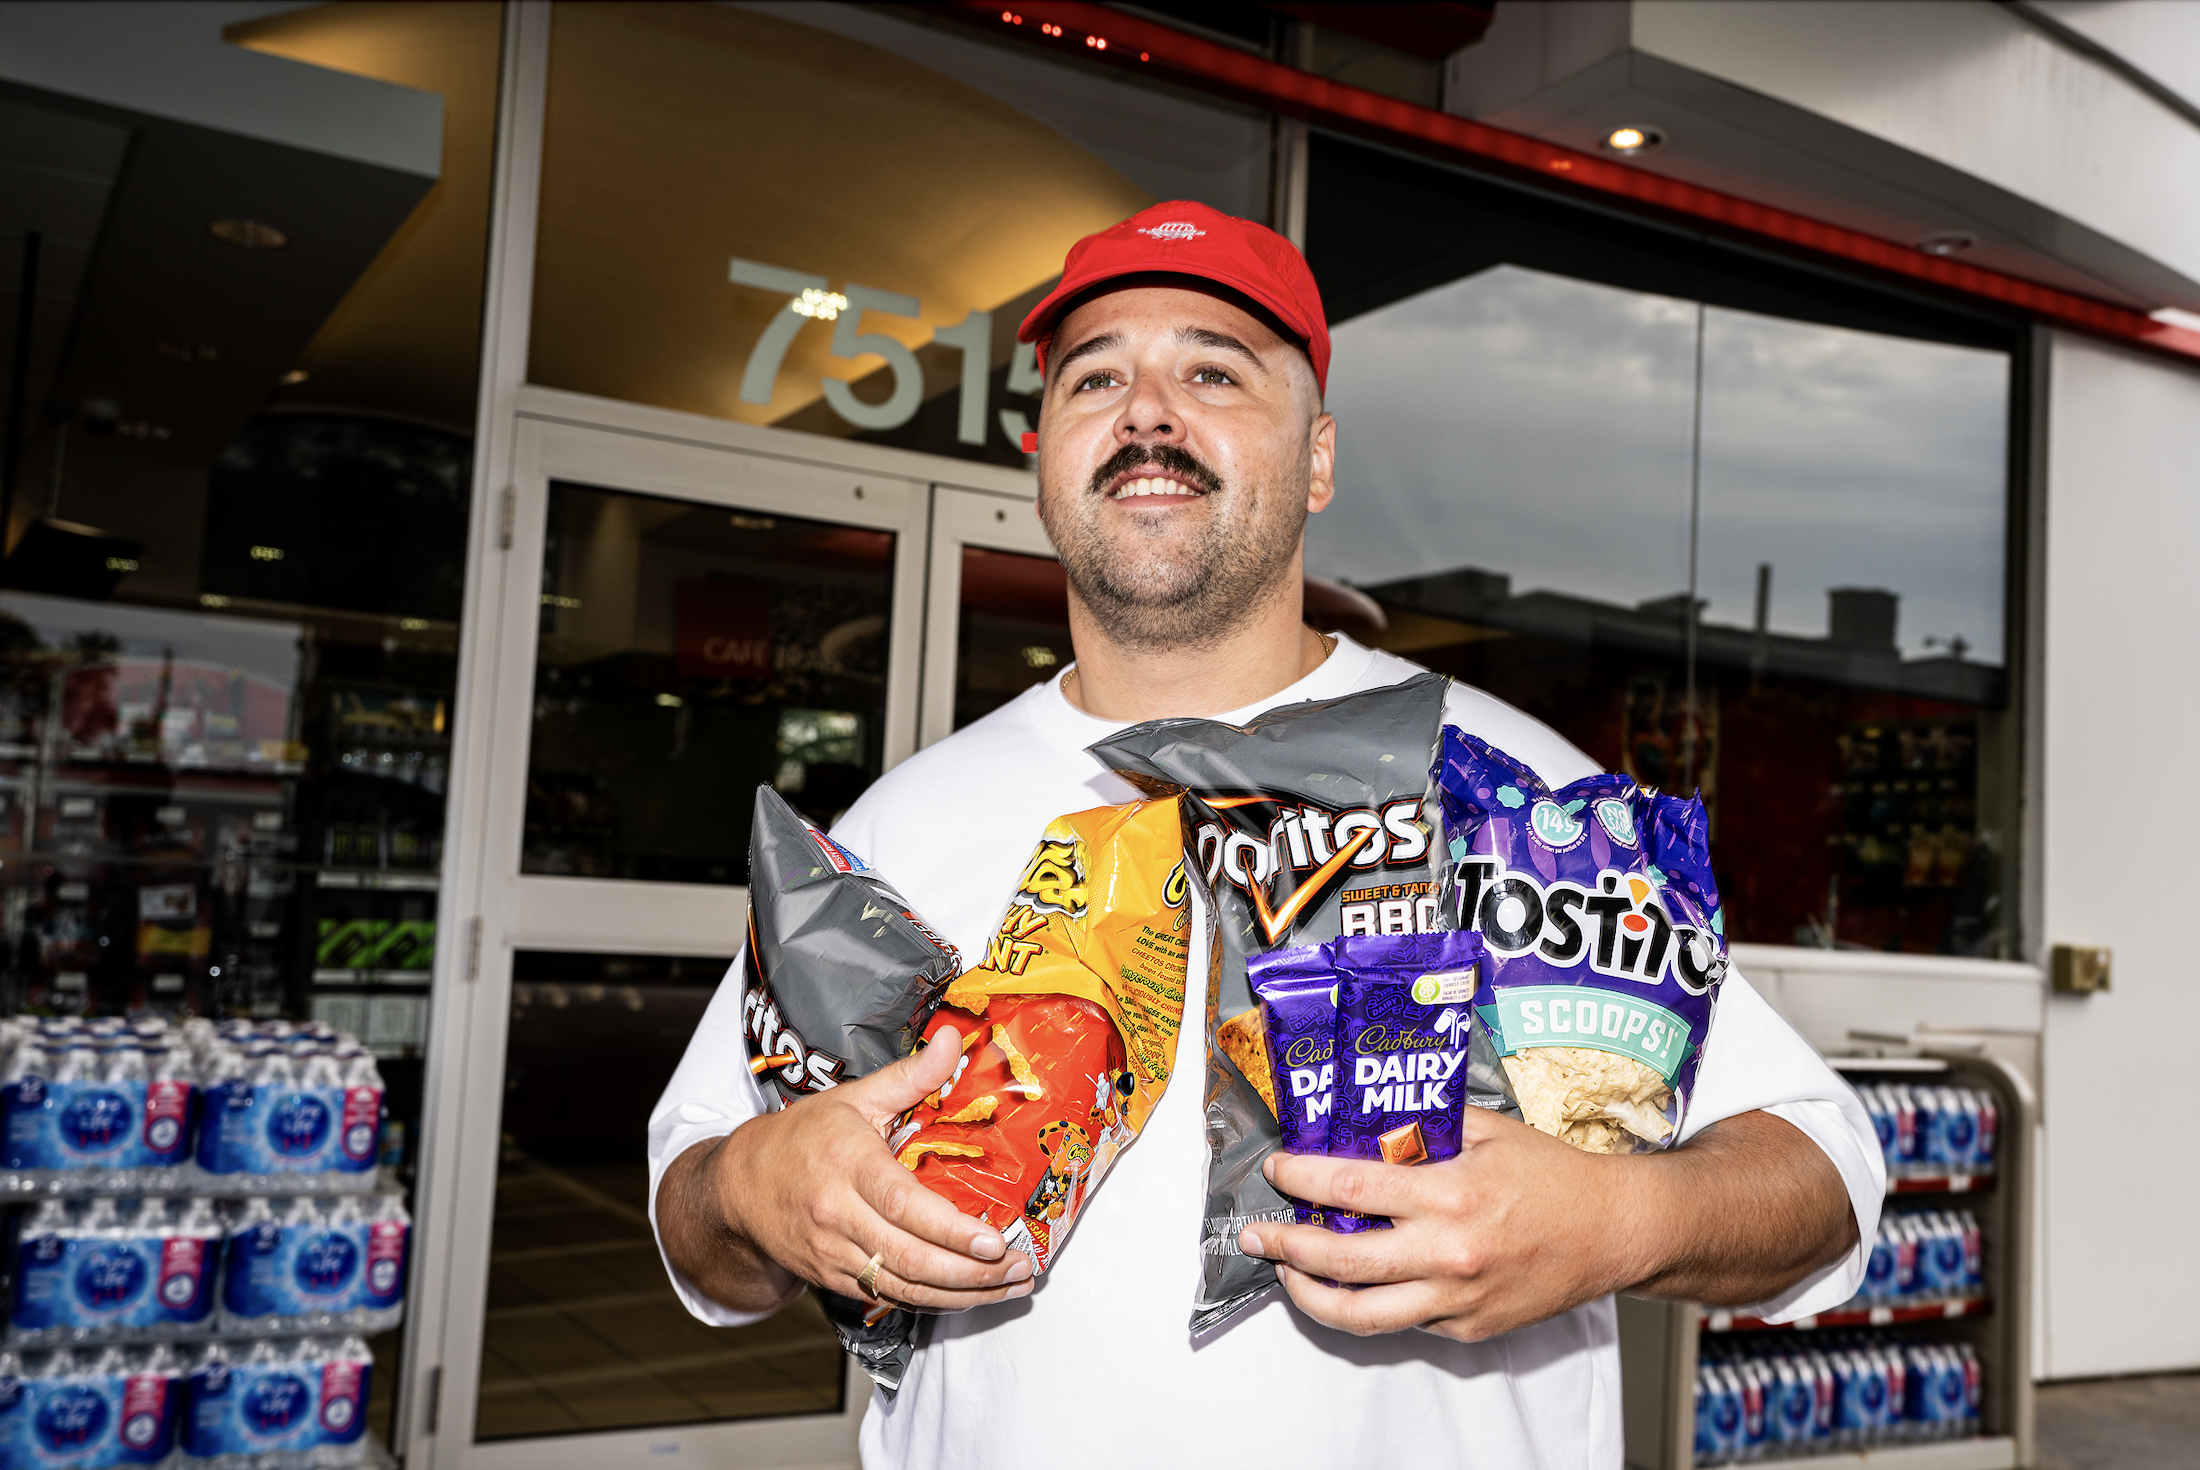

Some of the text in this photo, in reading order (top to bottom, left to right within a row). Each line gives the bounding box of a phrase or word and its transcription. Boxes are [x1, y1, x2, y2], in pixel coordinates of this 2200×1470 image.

[1197, 801, 1428, 887] Doritos
[1341, 886, 1390, 903] SWEET
[1391, 885, 1401, 897] &
[1141, 925, 1155, 937] The
[1154, 932, 1175, 945] GREAT
[1458, 861, 1715, 991] Tostito
[1131, 947, 1164, 967] CHEETOS
[1136, 936, 1155, 950] LOVE
[1154, 943, 1168, 955] with
[1139, 961, 1157, 976] been
[1156, 970, 1177, 985] found
[1295, 1008, 1320, 1030] DAIRY
[1371, 997, 1399, 1017] DAIRY
[743, 993, 840, 1092] ritos
[1354, 1024, 1447, 1055] Cadbury
[1519, 1000, 1675, 1059] SCOOPS!
[1355, 1050, 1466, 1086] DAIRY
[1362, 1081, 1450, 1115] MILK
